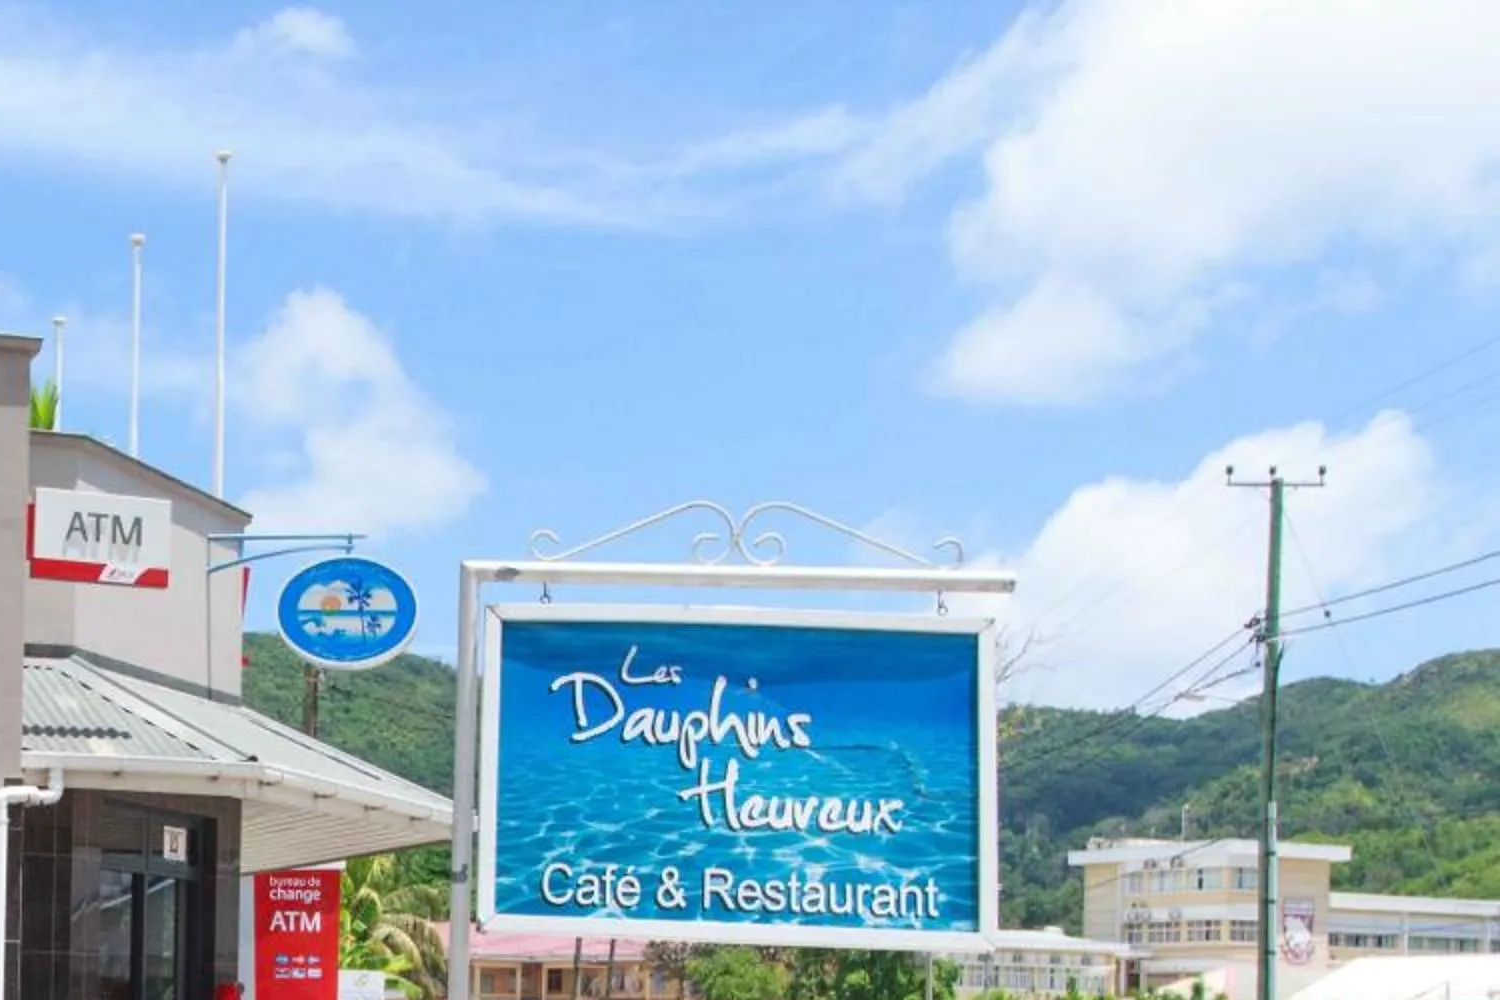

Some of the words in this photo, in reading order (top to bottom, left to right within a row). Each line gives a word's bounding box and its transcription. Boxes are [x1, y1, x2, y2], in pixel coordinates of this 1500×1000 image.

[66, 511, 143, 547] ATM
[621, 645, 682, 684] Les
[550, 673, 812, 769] Dauphins
[269, 876, 306, 887] bureau
[308, 876, 321, 887] de
[269, 888, 321, 904] change
[541, 862, 642, 906] Café
[657, 867, 687, 909] &
[703, 868, 939, 917] Restaurant
[269, 911, 321, 932] ATM
